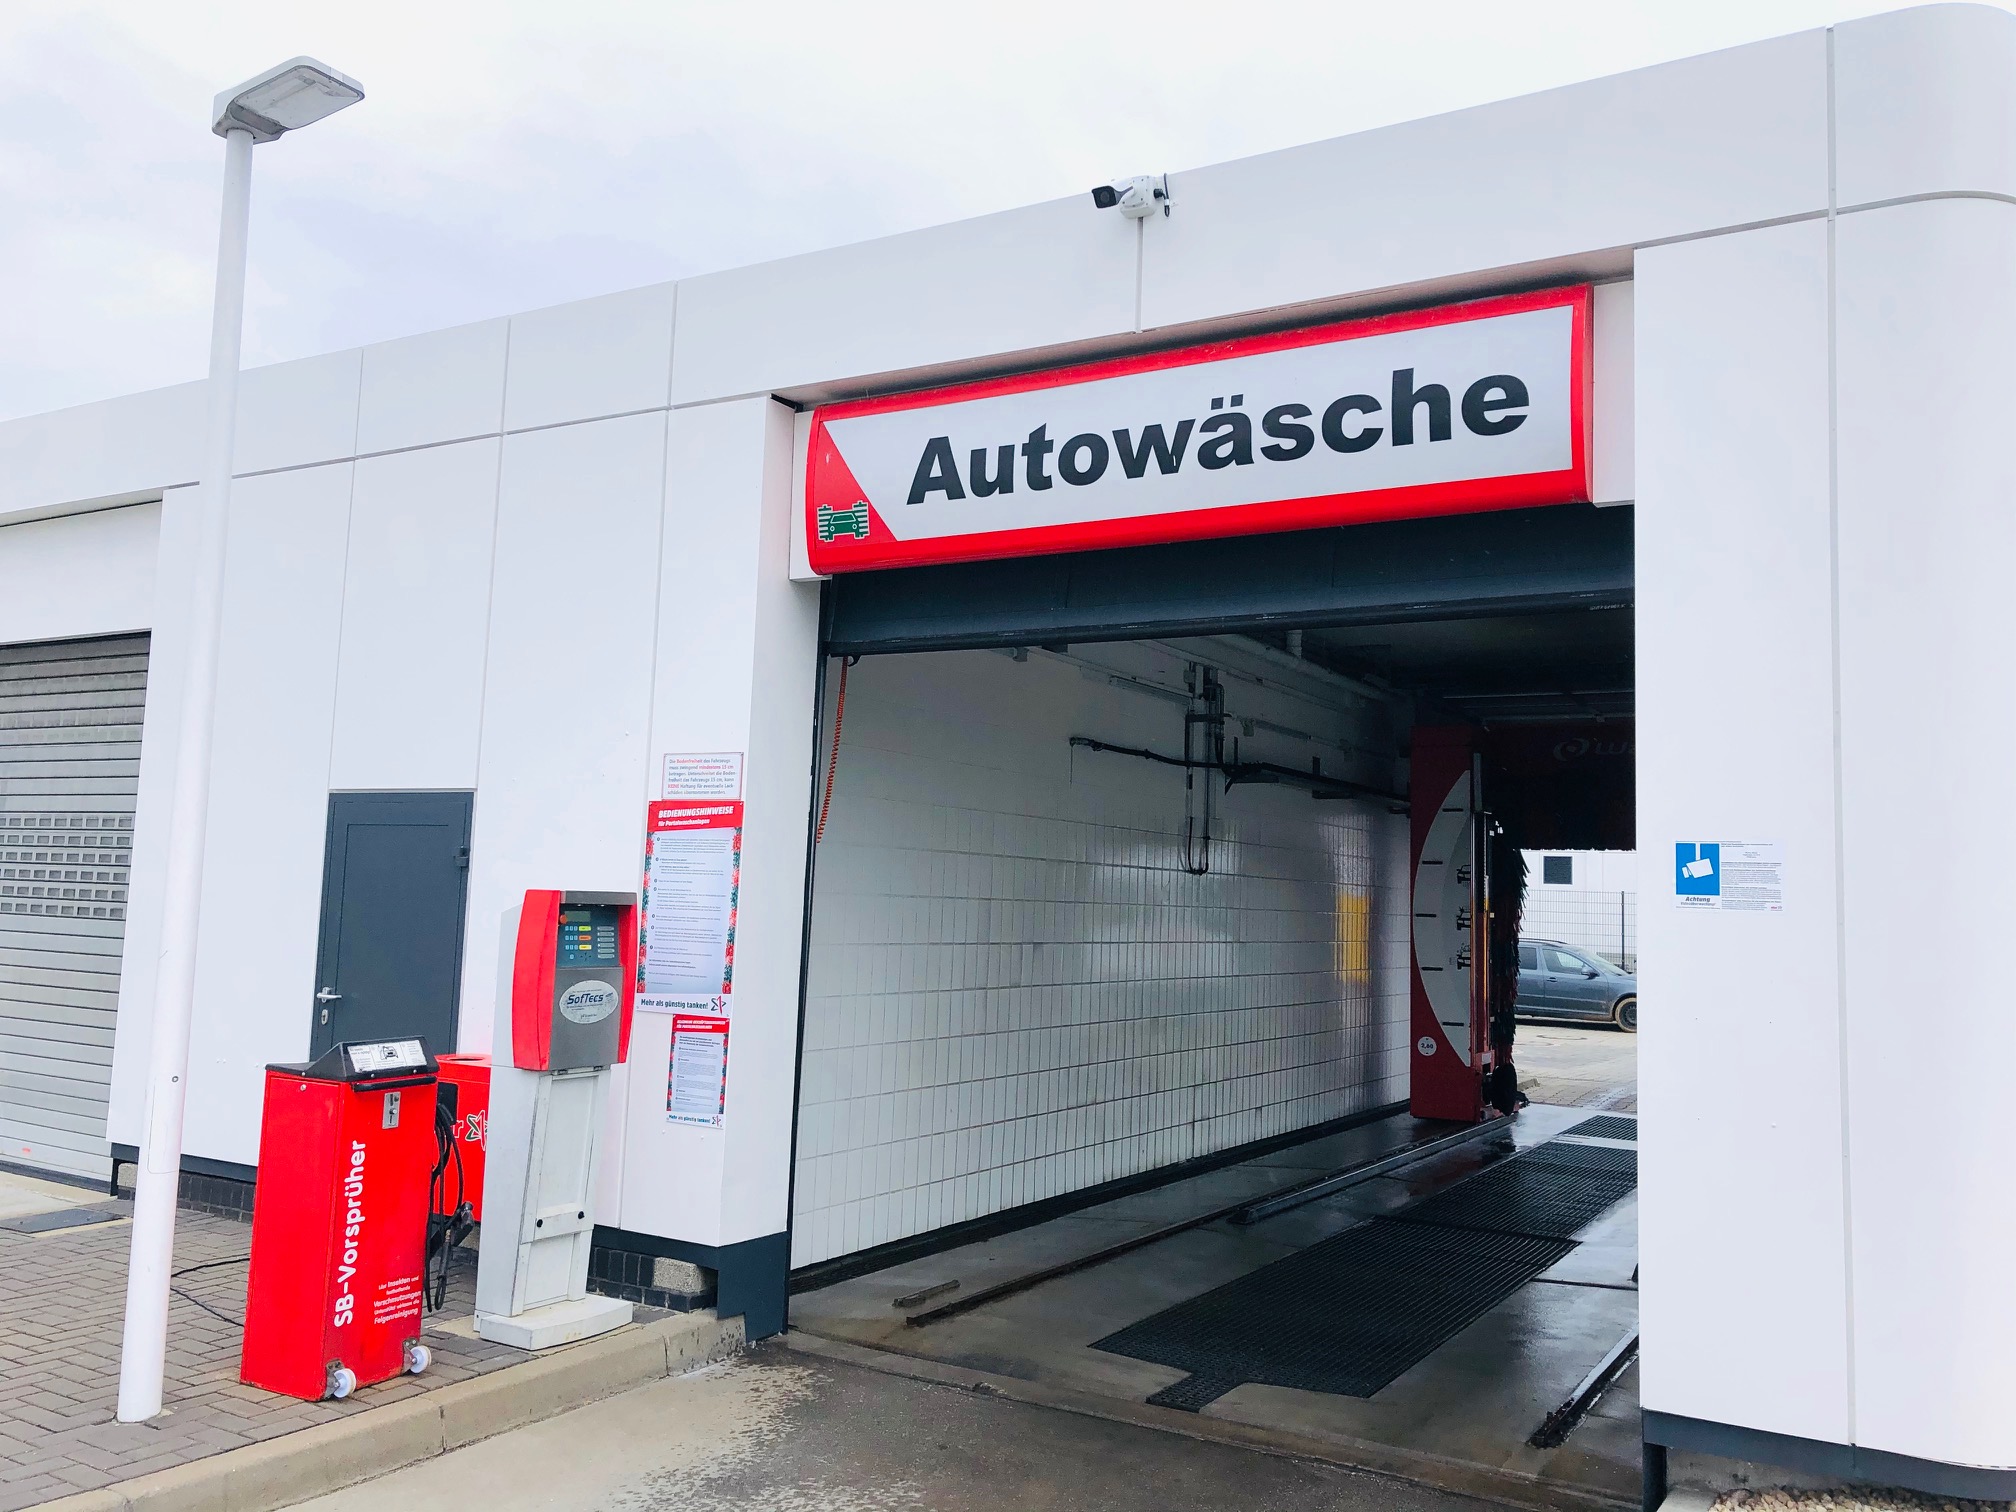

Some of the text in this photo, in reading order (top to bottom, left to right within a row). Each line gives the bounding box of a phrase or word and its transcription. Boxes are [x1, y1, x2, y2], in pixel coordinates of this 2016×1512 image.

[906, 367, 1529, 505] Autowäsche
[658, 806, 734, 818] BEDIENUNGSHINWEISE
[567, 993, 604, 1005] SofTecs
[641, 998, 709, 1010] Mehr als günstig tanken!
[334, 1140, 366, 1328] SB-Vorsprüher
[388, 1278, 410, 1288] Insekten
[374, 1291, 421, 1307] Verschmutzungen
[374, 1308, 418, 1325] Felgenreinigung
